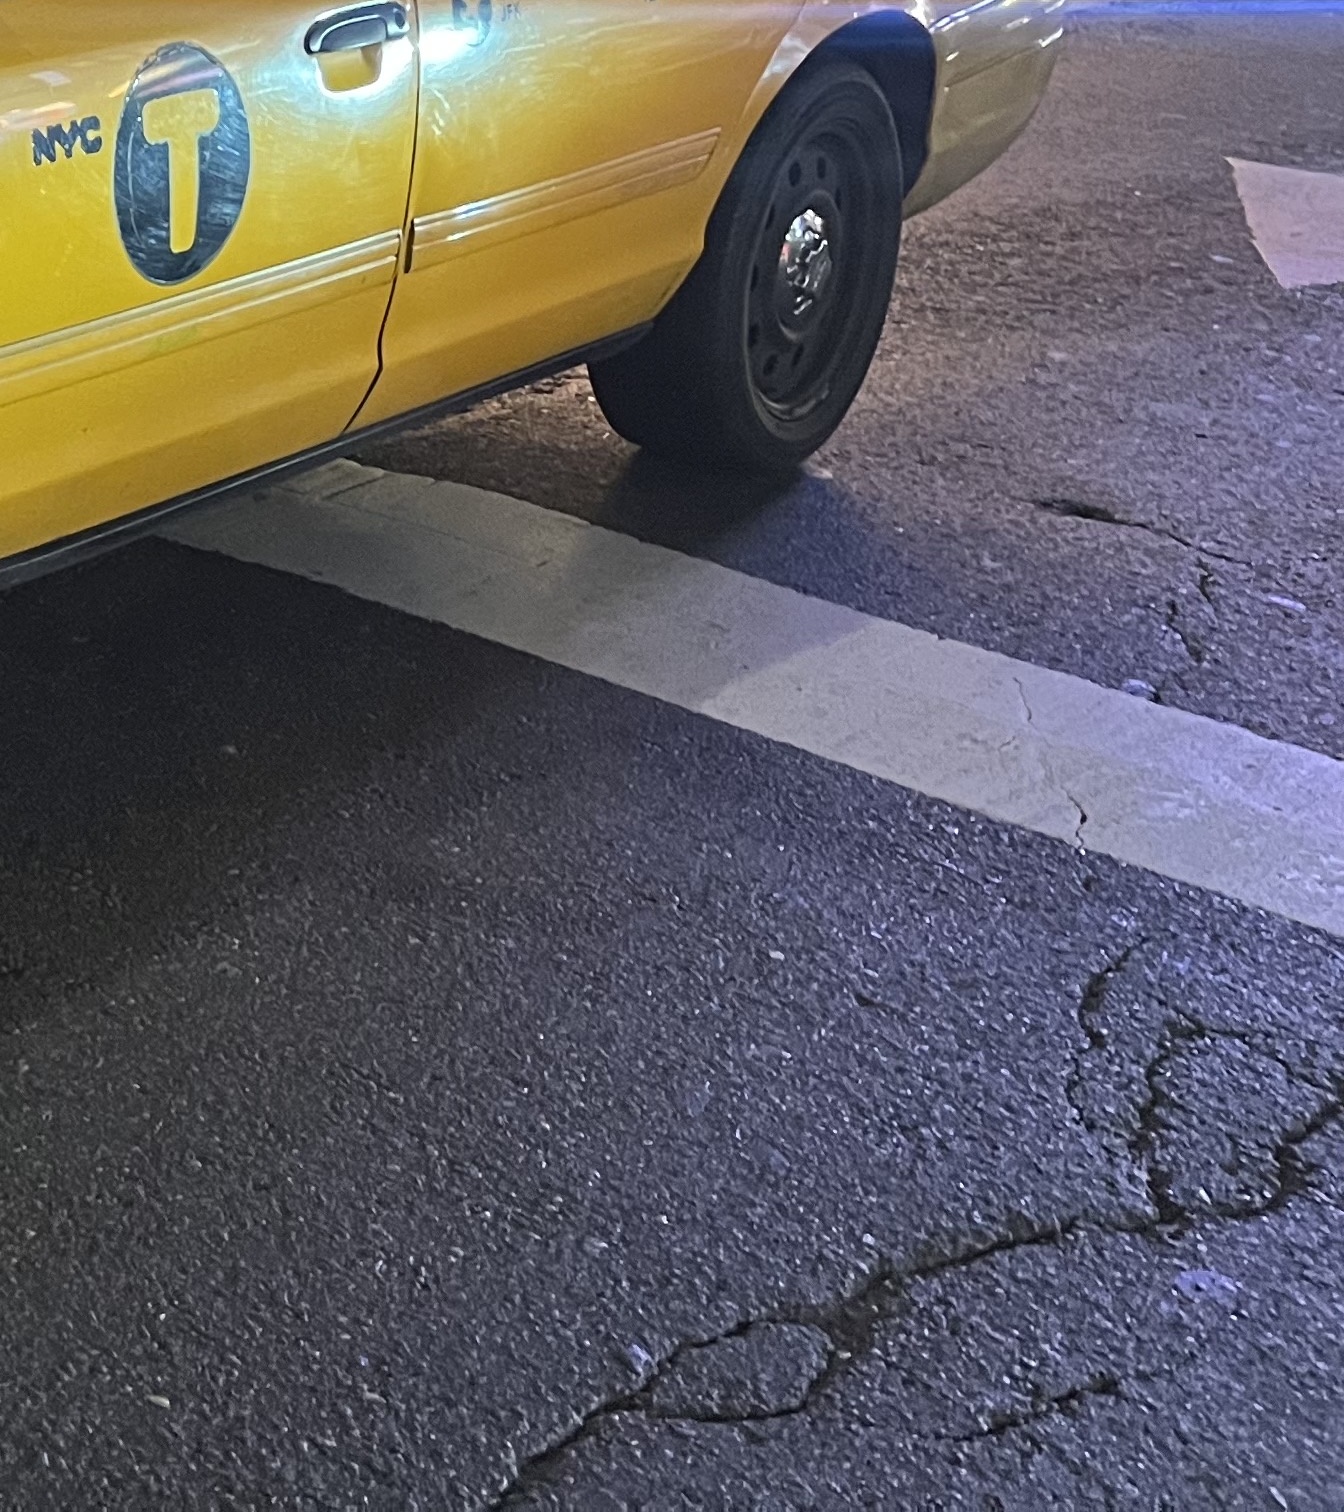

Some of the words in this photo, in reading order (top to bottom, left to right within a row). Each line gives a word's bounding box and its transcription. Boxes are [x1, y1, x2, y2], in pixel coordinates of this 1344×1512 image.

[500, 3, 522, 23] JFK
[31, 114, 103, 167] NYC
[141, 88, 221, 255] T
